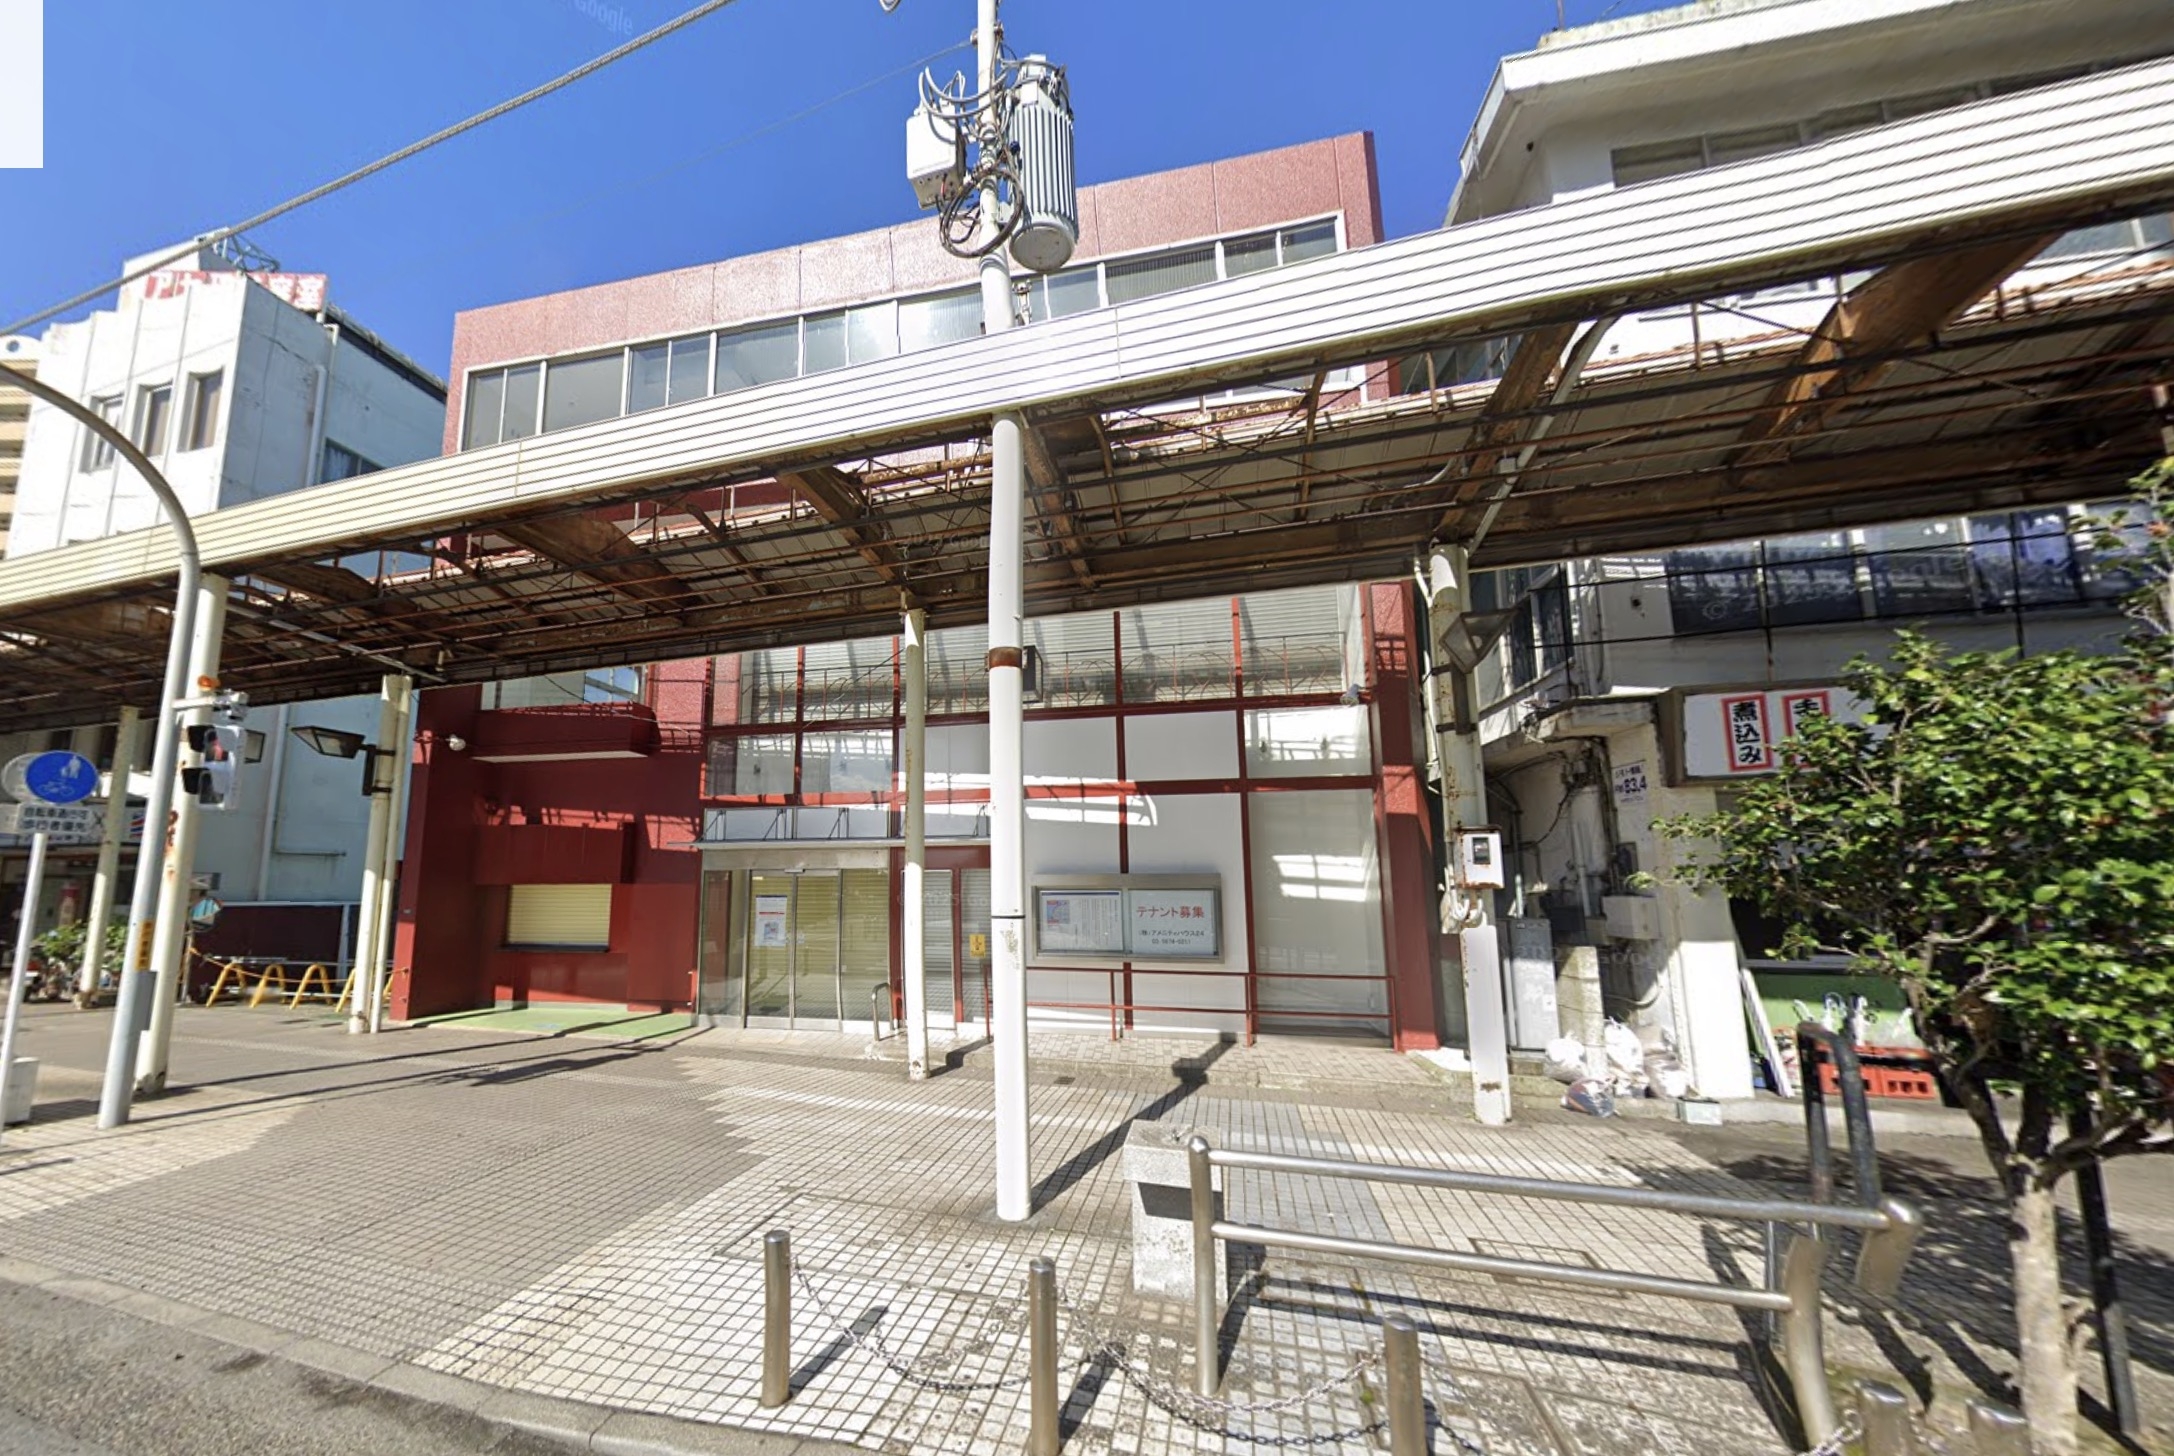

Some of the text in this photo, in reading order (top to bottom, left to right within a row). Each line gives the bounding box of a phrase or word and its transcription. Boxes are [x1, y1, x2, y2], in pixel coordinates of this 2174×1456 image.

[1732, 701, 1762, 764] 煮込み
[1136, 906, 1205, 919] テナント募集
